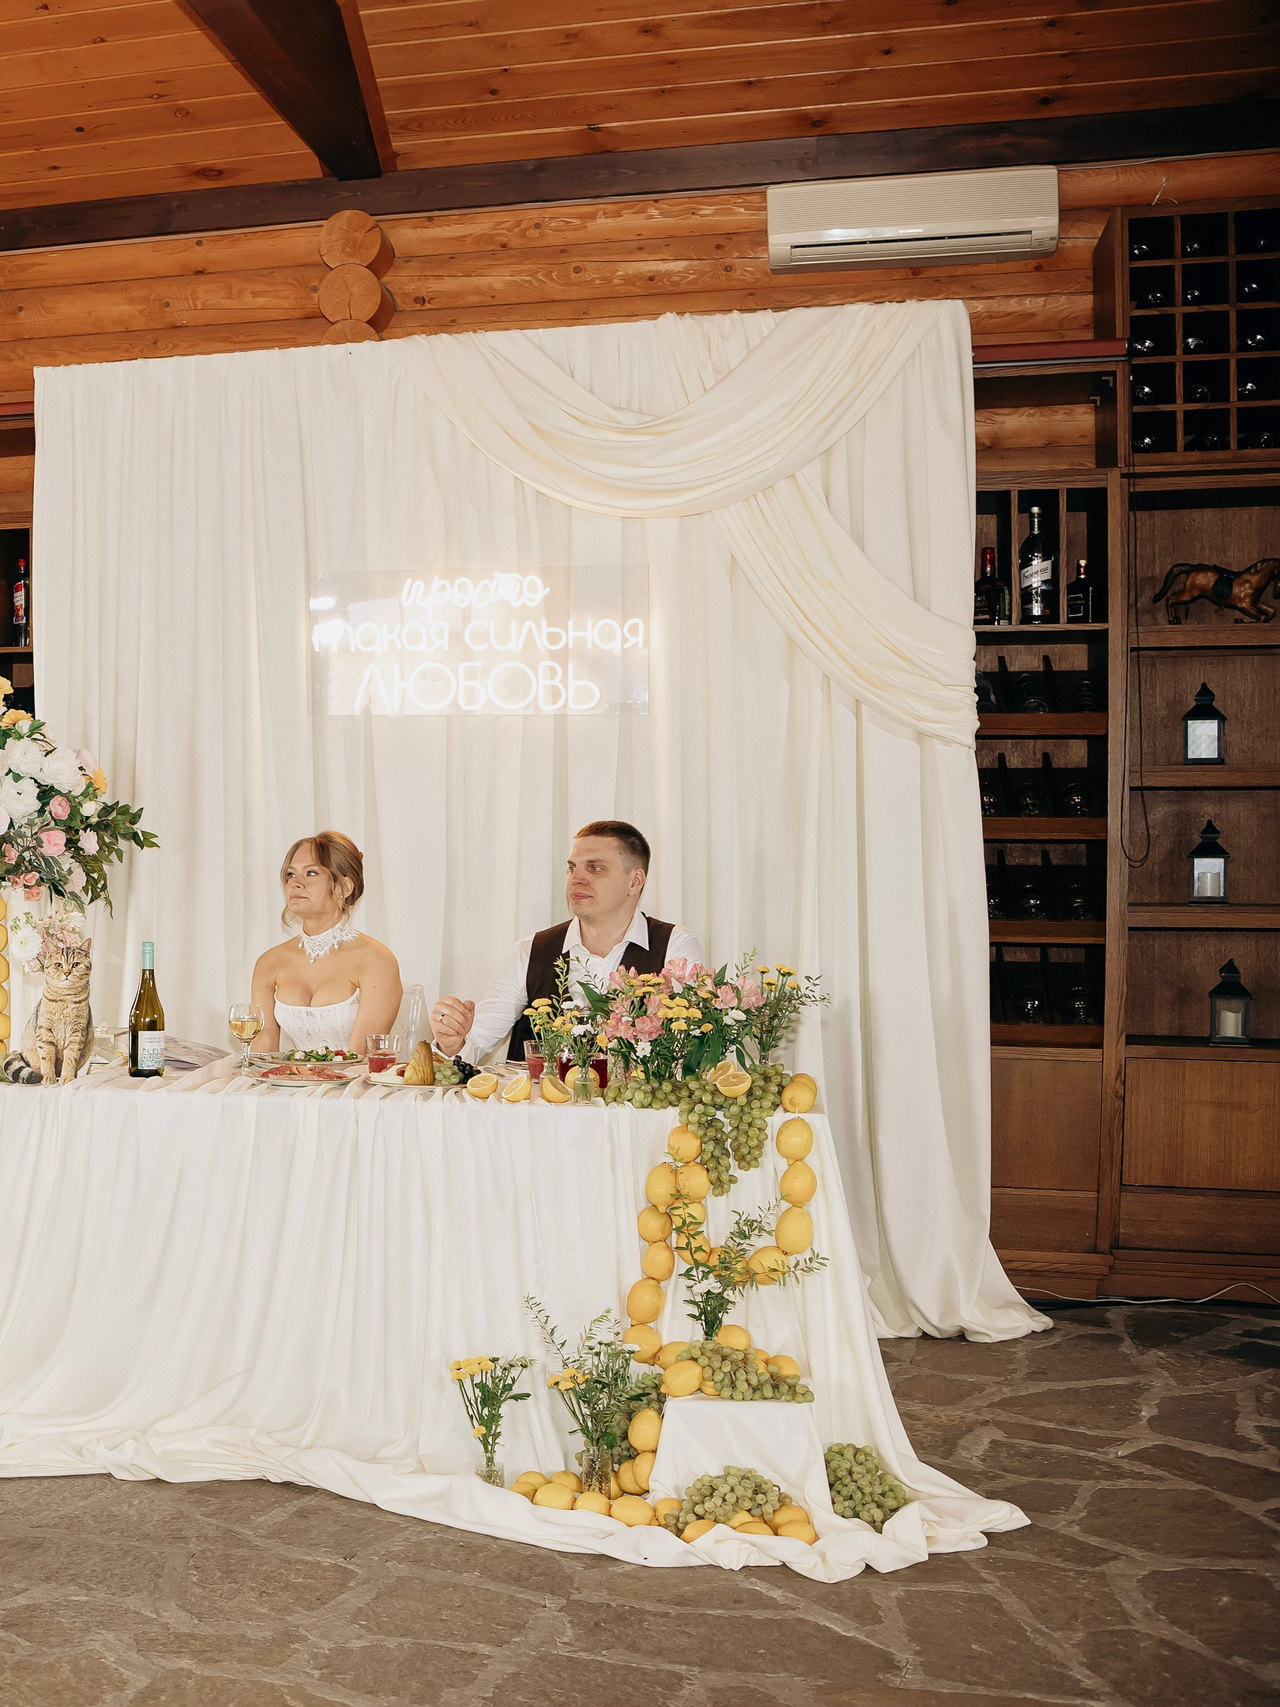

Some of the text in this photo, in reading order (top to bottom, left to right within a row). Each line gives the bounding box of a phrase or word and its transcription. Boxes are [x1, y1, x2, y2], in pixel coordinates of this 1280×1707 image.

[400, 571, 551, 622] просто
[463, 616, 645, 651] сильная
[353, 659, 601, 712] ЛЮБОВЬ
